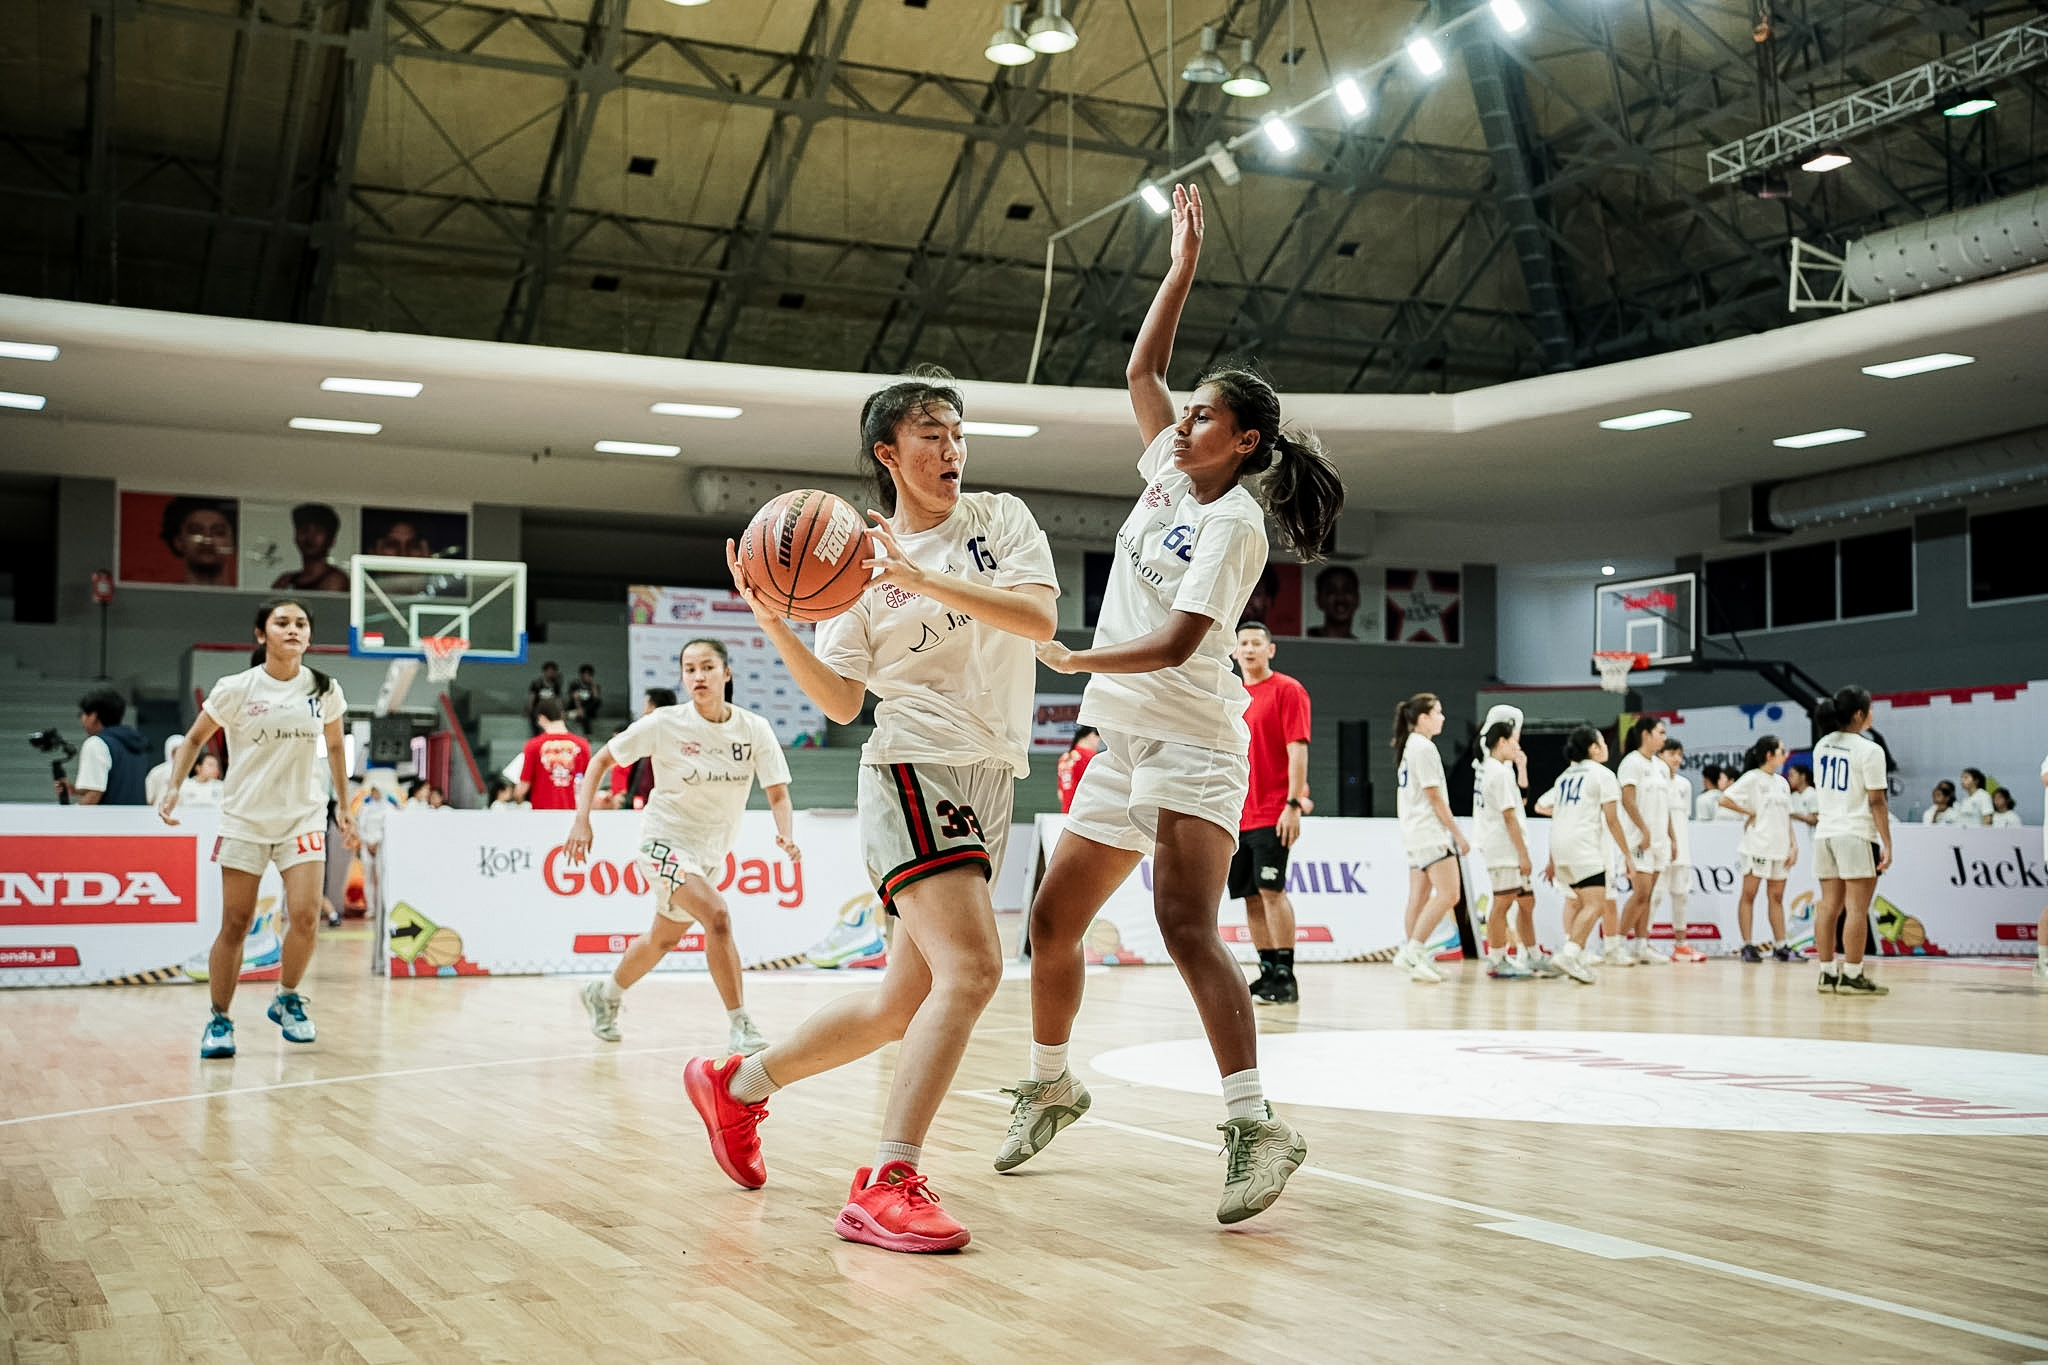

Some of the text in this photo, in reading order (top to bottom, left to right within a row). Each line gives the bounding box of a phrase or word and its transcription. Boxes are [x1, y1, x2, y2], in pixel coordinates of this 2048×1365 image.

[732, 743, 751, 761] 87
[1820, 755, 1849, 791] 110
[543, 845, 651, 896] Goo
[1950, 845, 2048, 889] Jack
